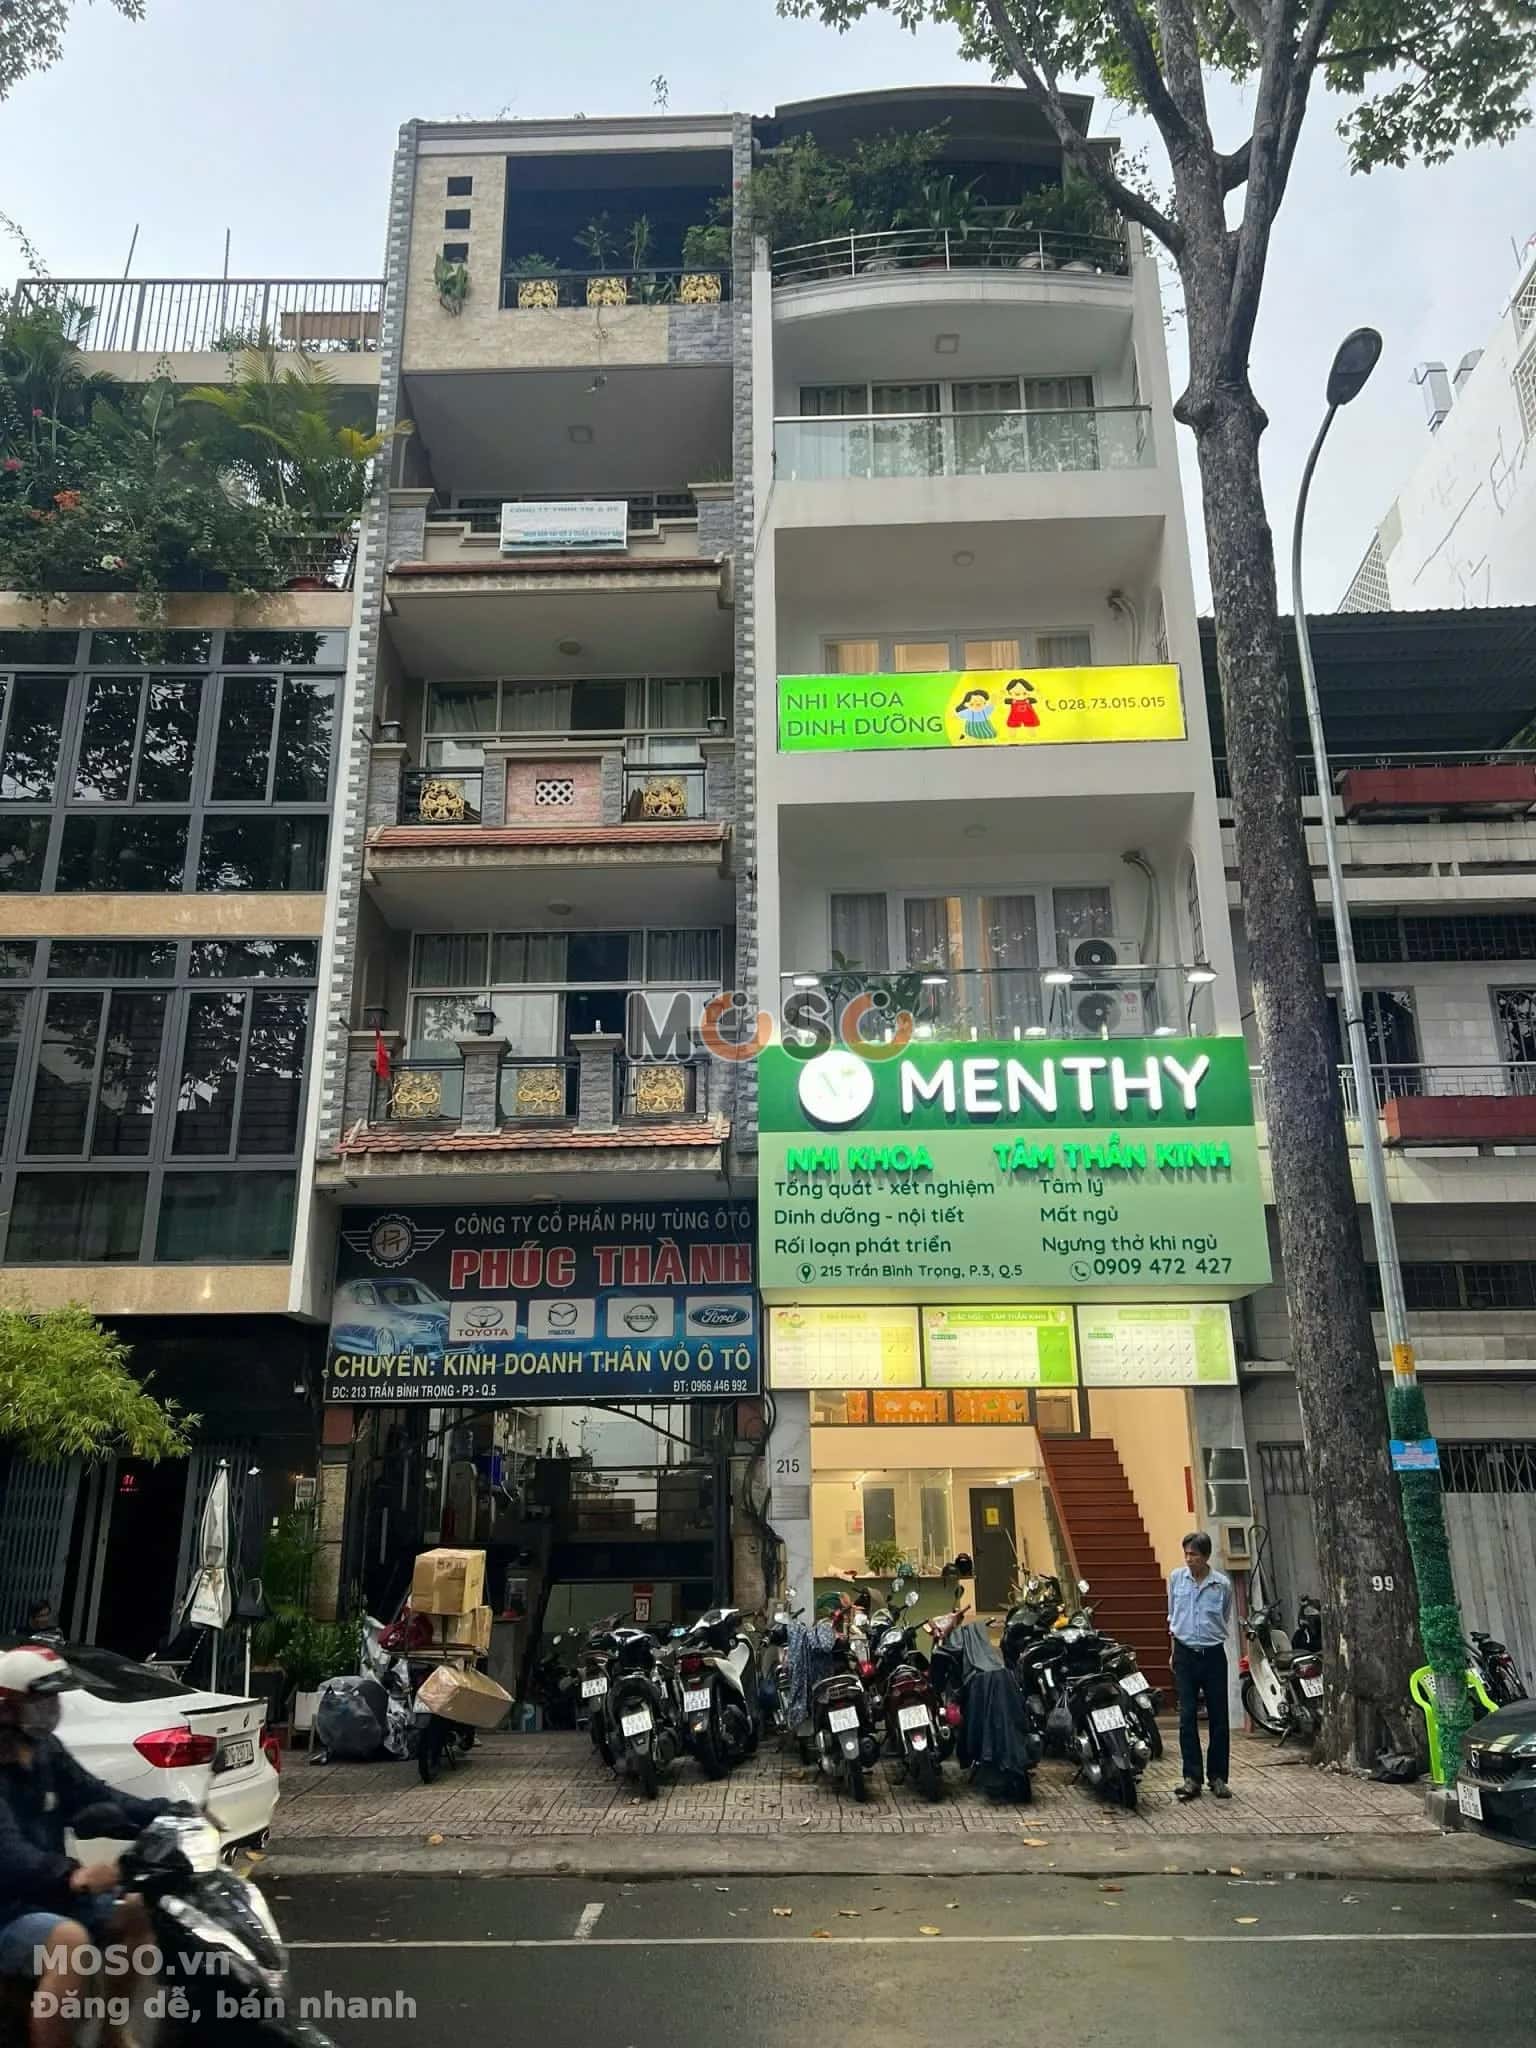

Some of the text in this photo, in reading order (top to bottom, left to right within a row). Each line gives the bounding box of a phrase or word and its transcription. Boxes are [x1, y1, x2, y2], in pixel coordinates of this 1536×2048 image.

[787, 691, 904, 710] NHI KHOA
[1058, 696, 1166, 711] 028.73.015.015
[787, 712, 943, 737] DINH DƯỠNG
[900, 1054, 1211, 1114] MENTHY
[786, 1143, 934, 1172] NHI KHOA
[992, 1130, 1231, 1171] TÂM THẦN KINH
[775, 1180, 823, 1199] Tổng
[828, 1180, 872, 1199] quát
[890, 1180, 920, 1195] xét
[925, 1180, 994, 1198] nghiệm
[1039, 1178, 1104, 1197] Tâm lý
[455, 1212, 505, 1235] CÔNG
[511, 1214, 534, 1234] TY
[537, 1208, 562, 1234] CỔ
[567, 1207, 616, 1233] PHẦN
[620, 1211, 655, 1233] PHỤ
[661, 1207, 710, 1231] TÙNG
[774, 1209, 815, 1225] Dinh
[820, 1205, 880, 1227] dưỡng
[898, 1208, 926, 1226] nội
[931, 1206, 965, 1224] tiết
[1040, 1205, 1119, 1225] Mất ngủ
[774, 1234, 952, 1257] Rối loạn phát triển
[1041, 1233, 1218, 1256] Ngưng thở khi ngủ
[449, 1236, 753, 1291] PHÚC THÀNH
[820, 1265, 842, 1278] 215
[882, 1263, 913, 1278] Bình
[918, 1264, 966, 1280] Trọng,
[969, 1264, 995, 1279] P.3,
[998, 1264, 1023, 1279] Q.5
[1093, 1257, 1233, 1276] 0909 472 427
[701, 1307, 738, 1323] Ford
[456, 1328, 510, 1338] TOYOTA
[334, 1349, 436, 1378] CHUYÊN:
[443, 1352, 497, 1376] KINH
[503, 1350, 583, 1375] DOANH
[590, 1344, 651, 1373] THÂN
[659, 1341, 690, 1371] VỎ
[697, 1343, 714, 1371] Ô
[720, 1342, 750, 1371] TÔ
[332, 1386, 349, 1398] ĐC:
[351, 1385, 367, 1398] 213
[396, 1382, 419, 1398] BÌNH
[421, 1384, 455, 1399] TRỌNG
[462, 1384, 474, 1397] P3
[481, 1384, 497, 1397] Q.5
[673, 1379, 689, 1393] ĐT:
[690, 1379, 712, 1392] 0966
[731, 1378, 748, 1392] 992
[775, 1458, 800, 1474] 215
[1371, 1575, 1394, 1592] 99
